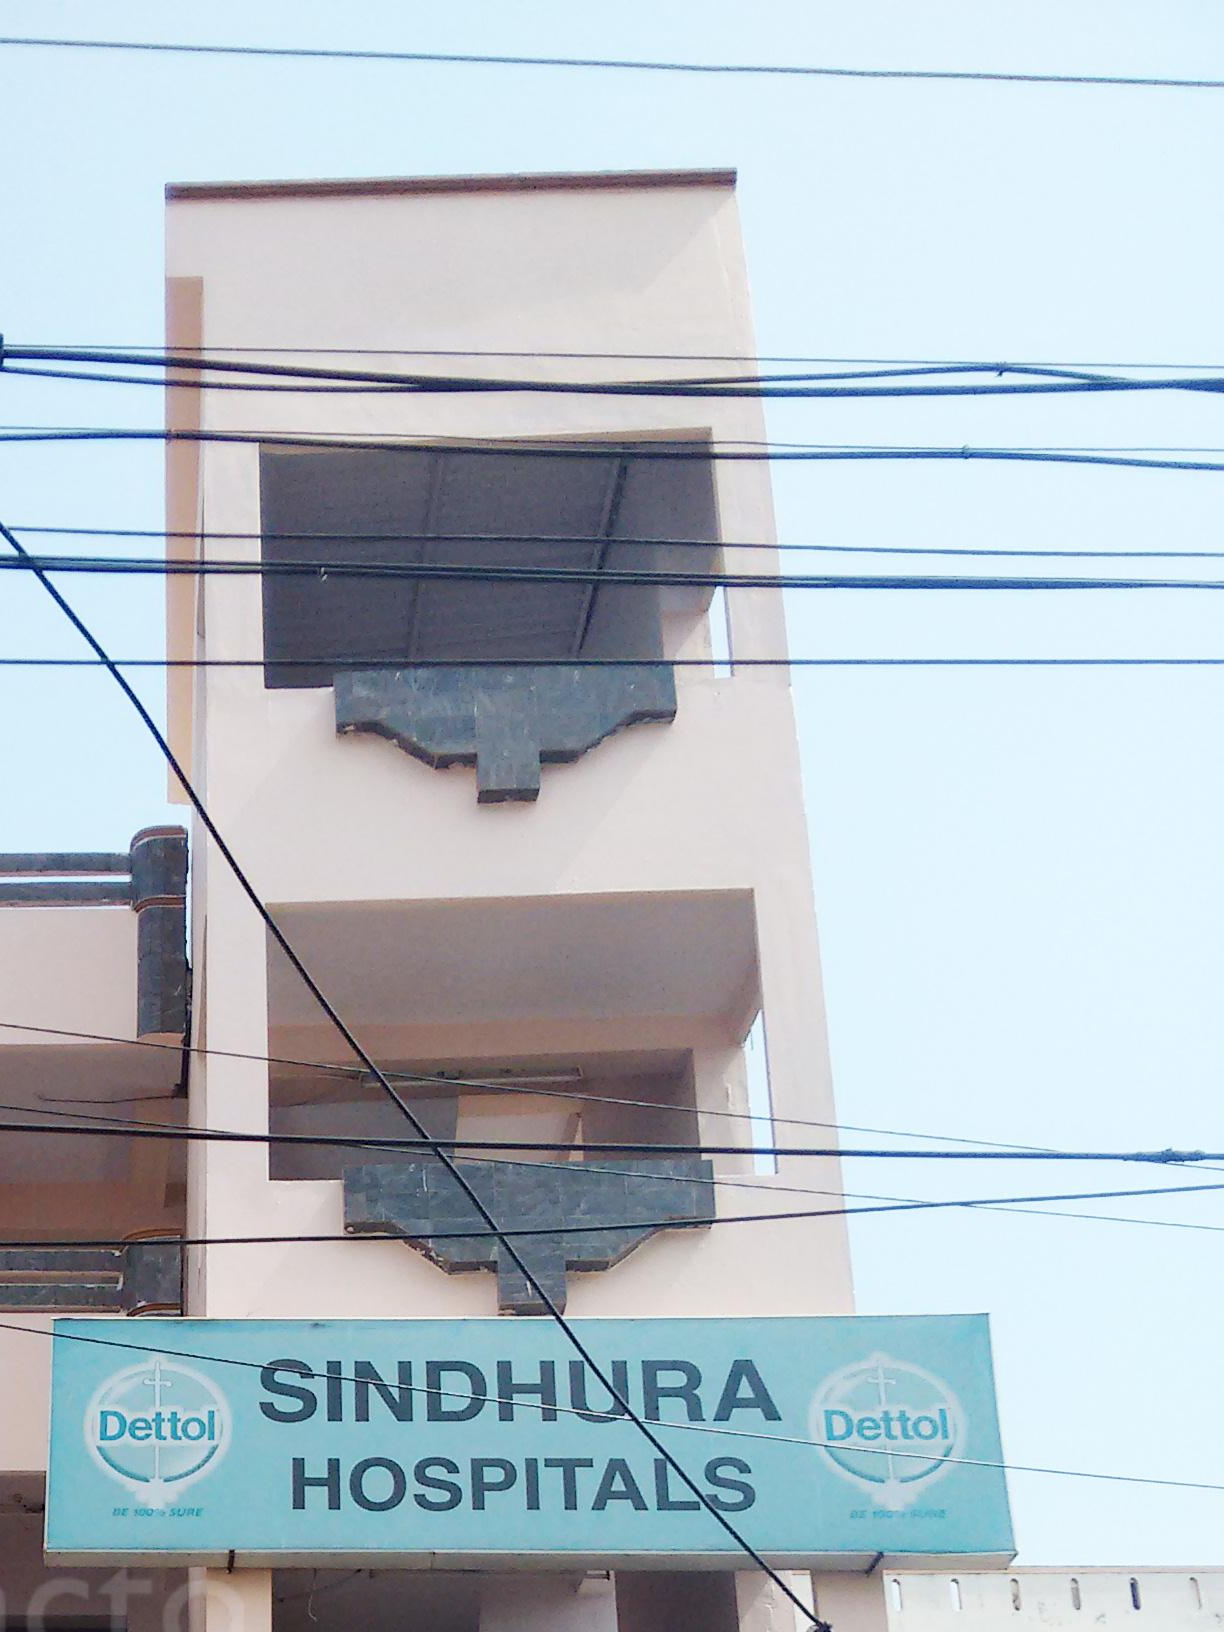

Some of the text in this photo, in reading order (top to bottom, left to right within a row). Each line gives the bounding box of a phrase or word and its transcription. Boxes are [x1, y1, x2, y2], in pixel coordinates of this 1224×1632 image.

[257, 1357, 782, 1424] SINDHURA
[99, 1410, 215, 1441] Dettol
[825, 1407, 950, 1443] Dettol
[290, 1454, 756, 1513] HOSPITALS
